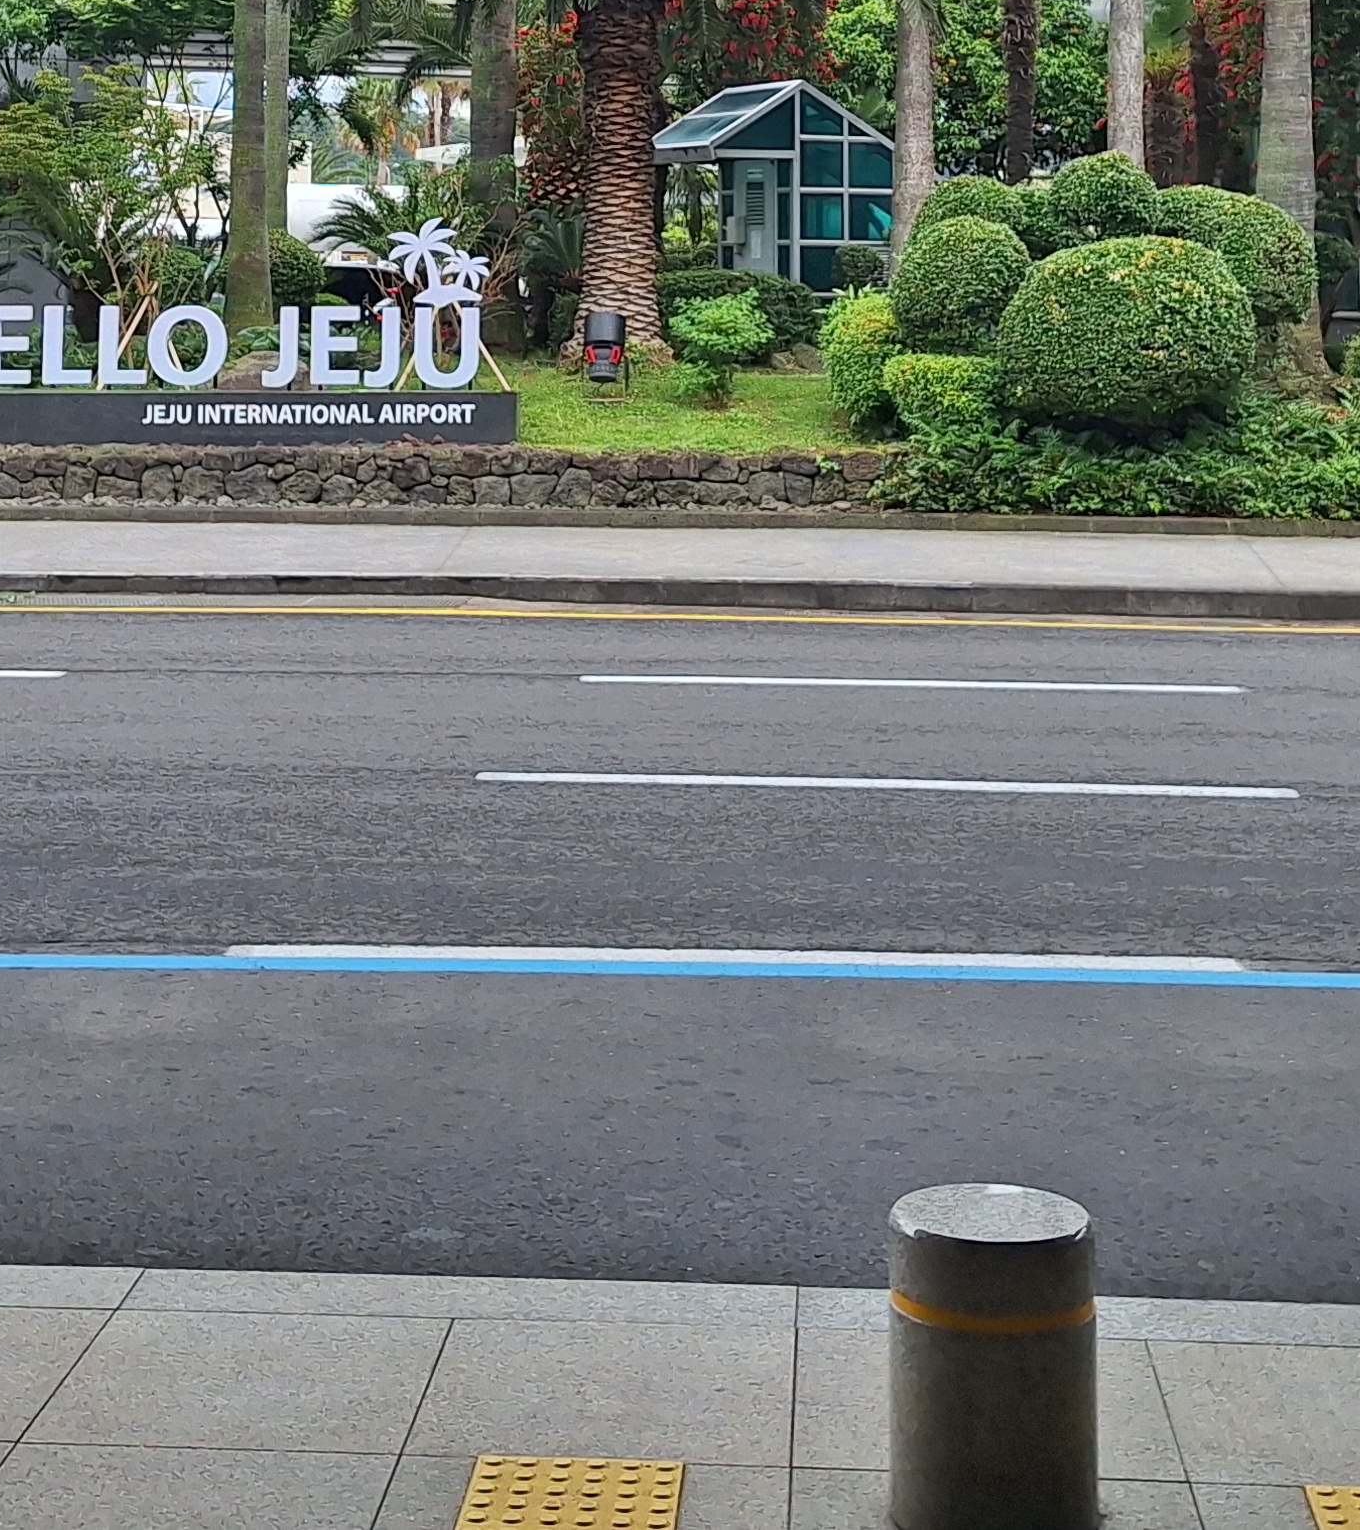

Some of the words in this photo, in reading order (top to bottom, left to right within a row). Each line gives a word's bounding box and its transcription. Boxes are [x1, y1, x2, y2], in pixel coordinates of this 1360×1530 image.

[261, 305, 480, 388] JEJU
[141, 403, 193, 425] JEJU
[197, 403, 375, 425] INTERNATIONAL
[378, 403, 477, 425] AIRPORT
